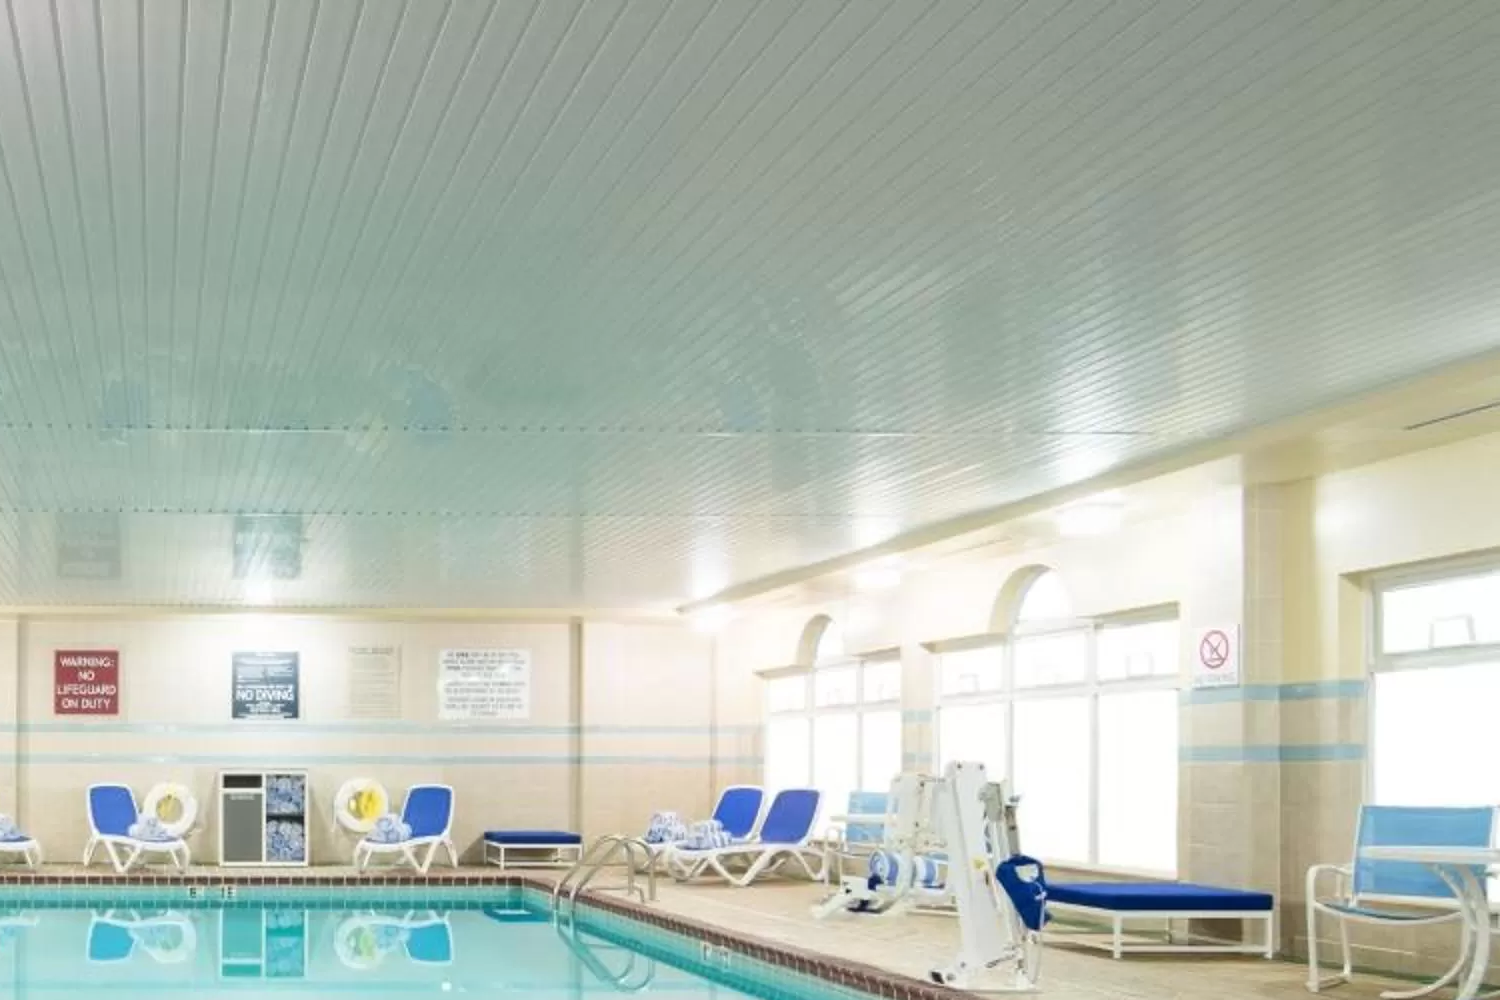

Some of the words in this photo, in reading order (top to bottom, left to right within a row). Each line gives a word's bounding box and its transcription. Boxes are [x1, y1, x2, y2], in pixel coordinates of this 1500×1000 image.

[78, 669, 95, 681] NO
[57, 683, 117, 695] LIFEGUARD
[236, 690, 253, 701] NO
[255, 690, 294, 701] DIVING
[61, 698, 79, 709] ON
[81, 698, 111, 709] DUTY
